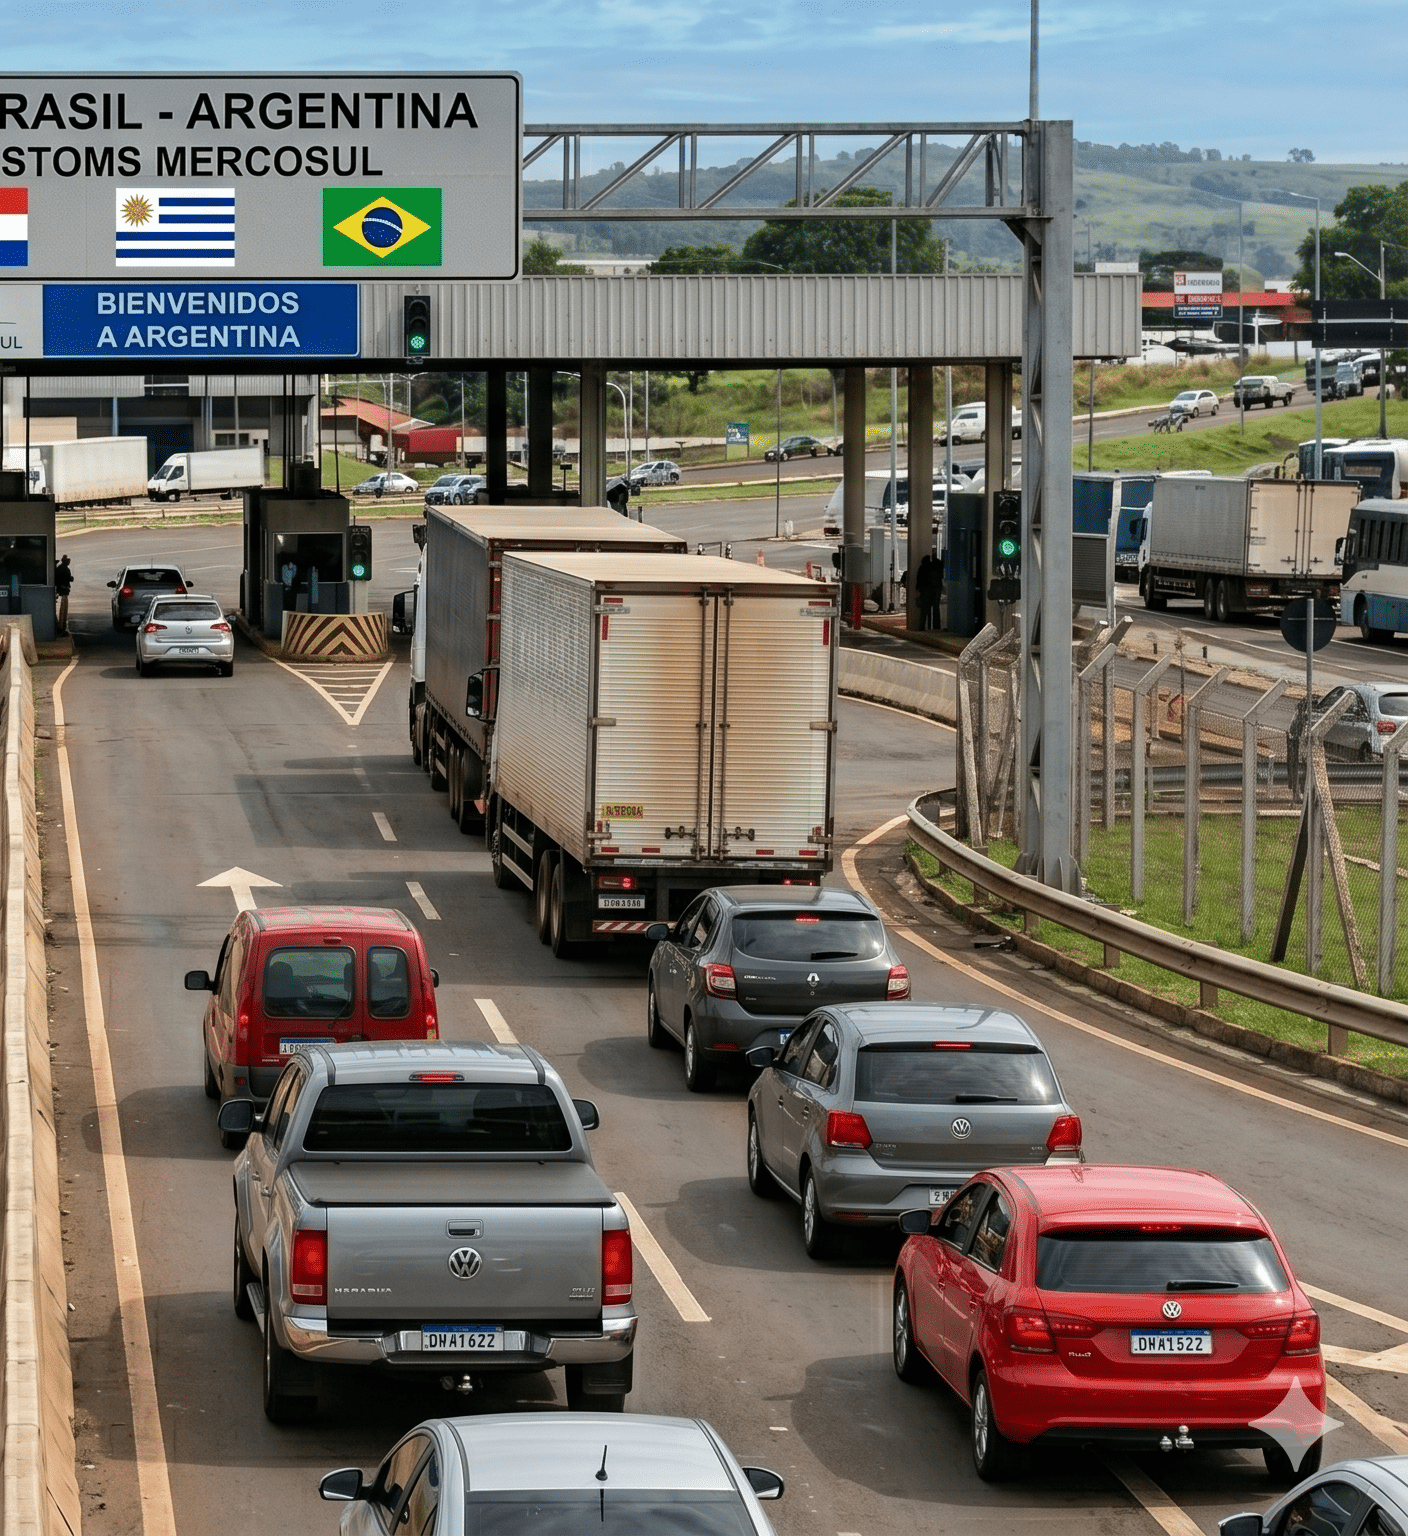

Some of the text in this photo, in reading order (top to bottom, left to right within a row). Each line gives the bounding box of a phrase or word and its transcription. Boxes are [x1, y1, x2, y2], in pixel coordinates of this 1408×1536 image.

[158, 111, 173, 120] -
[185, 92, 479, 130] ARGENTINA
[156, 145, 383, 177] MERCOSUL
[97, 291, 299, 315] BIENVENIDOS
[96, 325, 301, 348] A ARGENTINA
